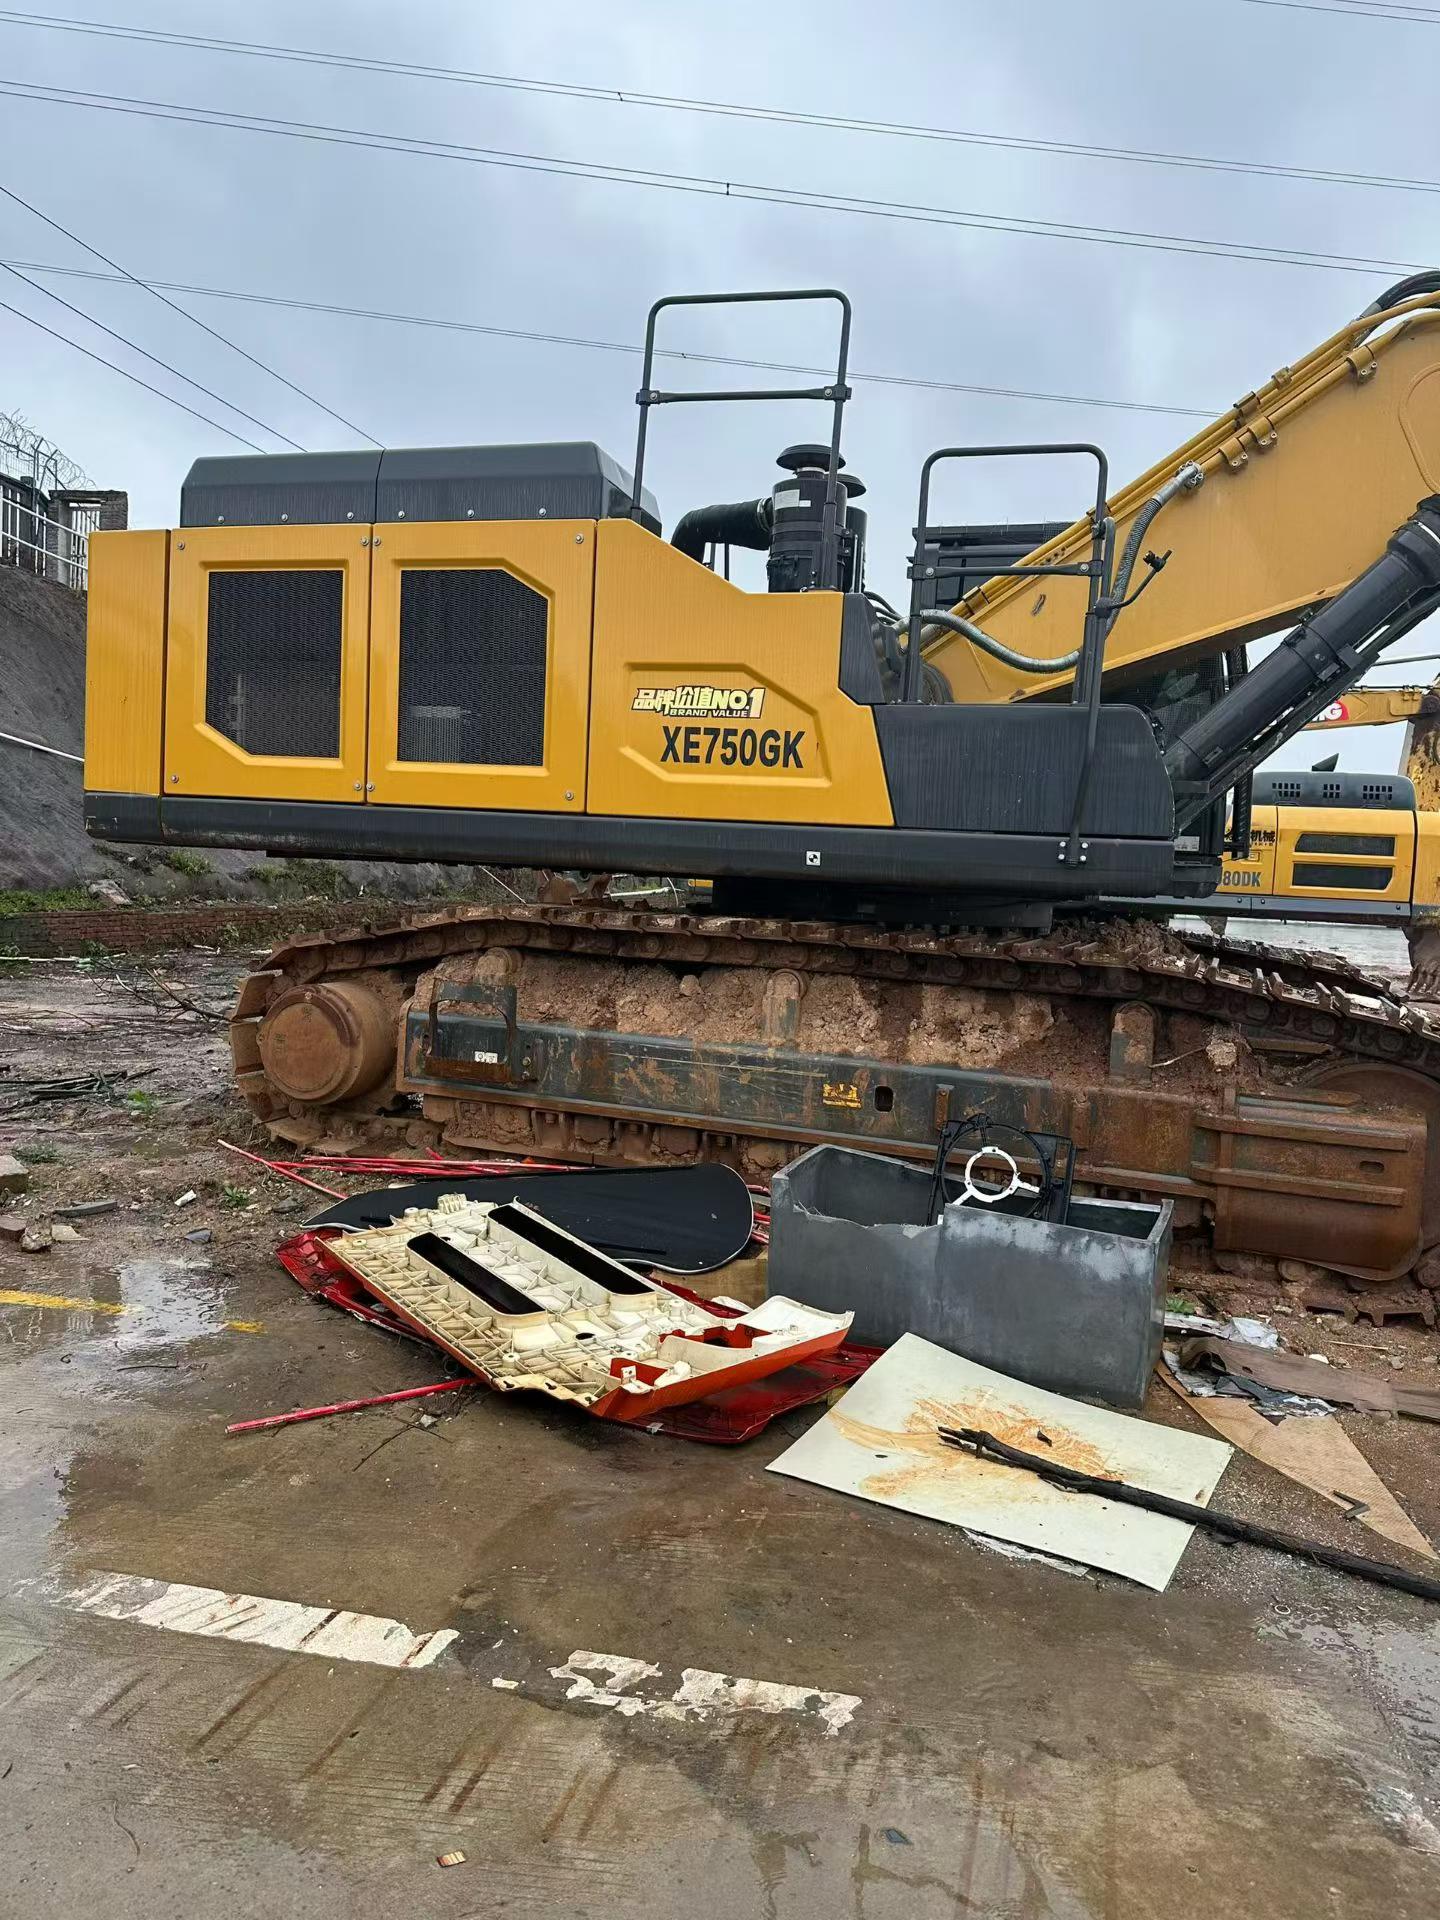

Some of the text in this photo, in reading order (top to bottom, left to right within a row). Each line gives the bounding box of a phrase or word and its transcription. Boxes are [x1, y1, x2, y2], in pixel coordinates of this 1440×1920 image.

[669, 708, 748, 717] BRAND VALUE
[660, 725, 806, 769] XE750GK
[1220, 870, 1262, 887] 80DK
